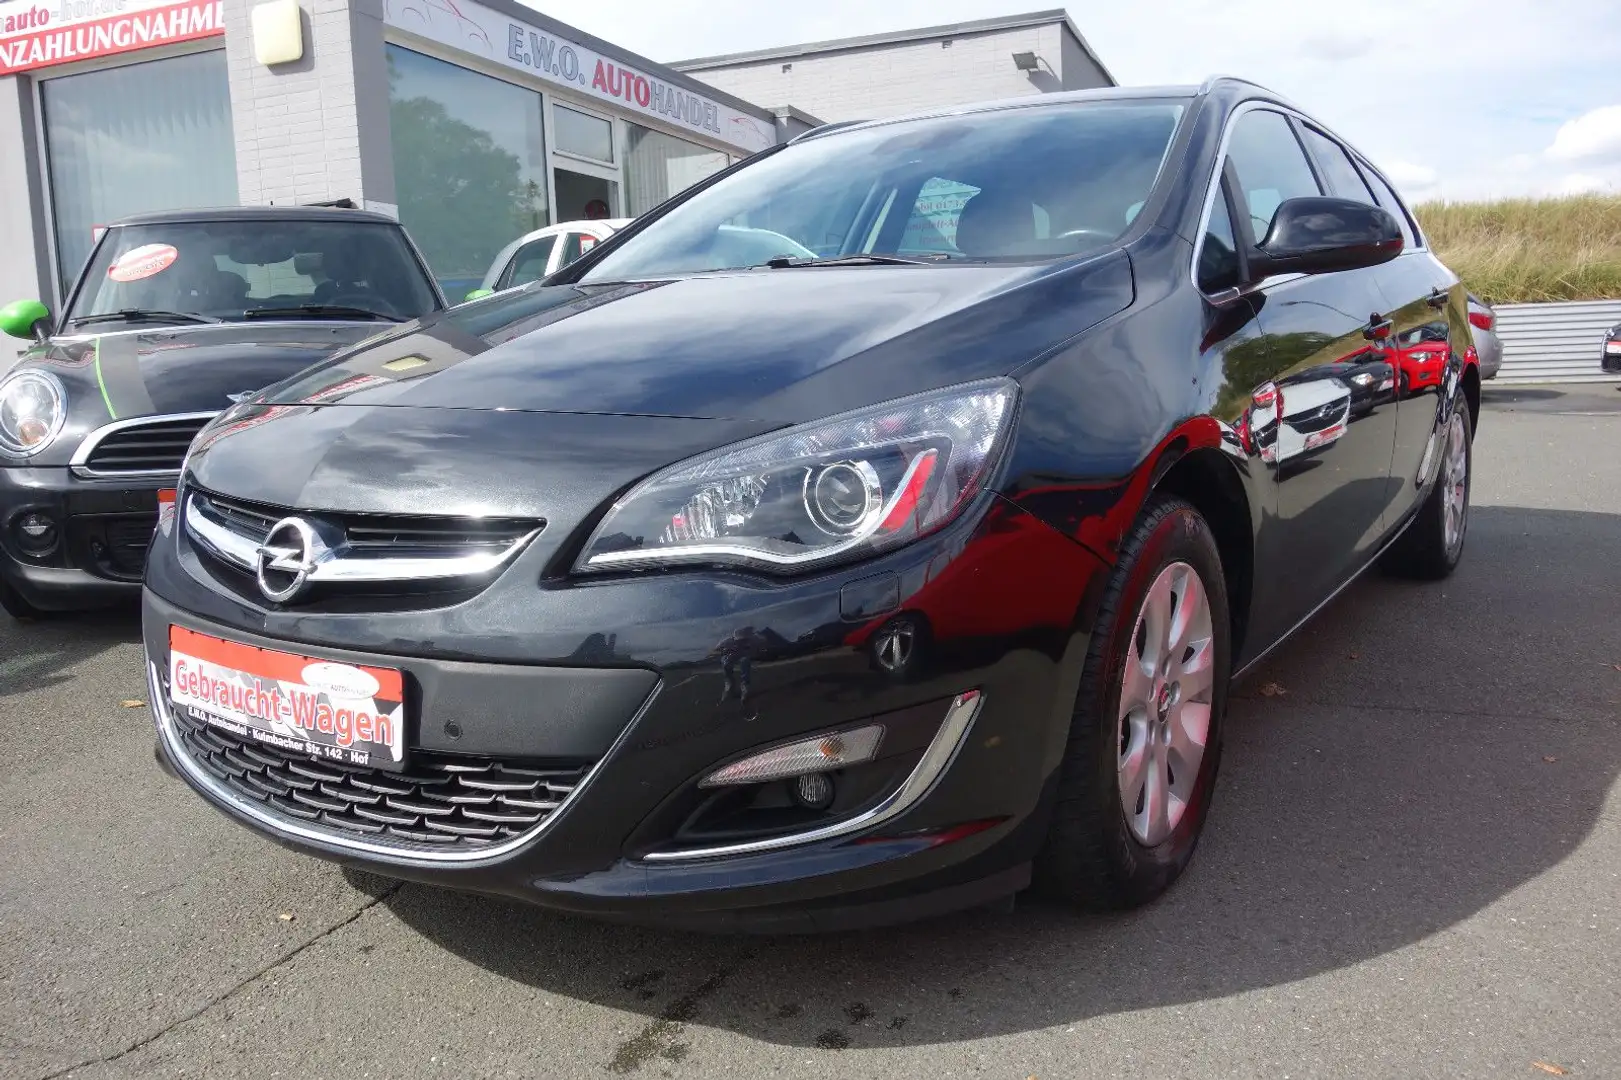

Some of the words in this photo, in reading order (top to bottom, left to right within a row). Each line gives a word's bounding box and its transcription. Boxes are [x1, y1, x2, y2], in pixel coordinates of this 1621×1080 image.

[508, 23, 586, 86] E.W.O.
[592, 59, 721, 133] AUTOHANDEL
[175, 658, 394, 746] Gebraucht-Wagen
[187, 706, 208, 723] E.W.O.
[208, 714, 248, 736] Autohandel
[252, 729, 303, 751] Kulmbacher
[305, 742, 322, 756] Str.
[325, 745, 342, 760] 142
[350, 750, 369, 765] Hof
